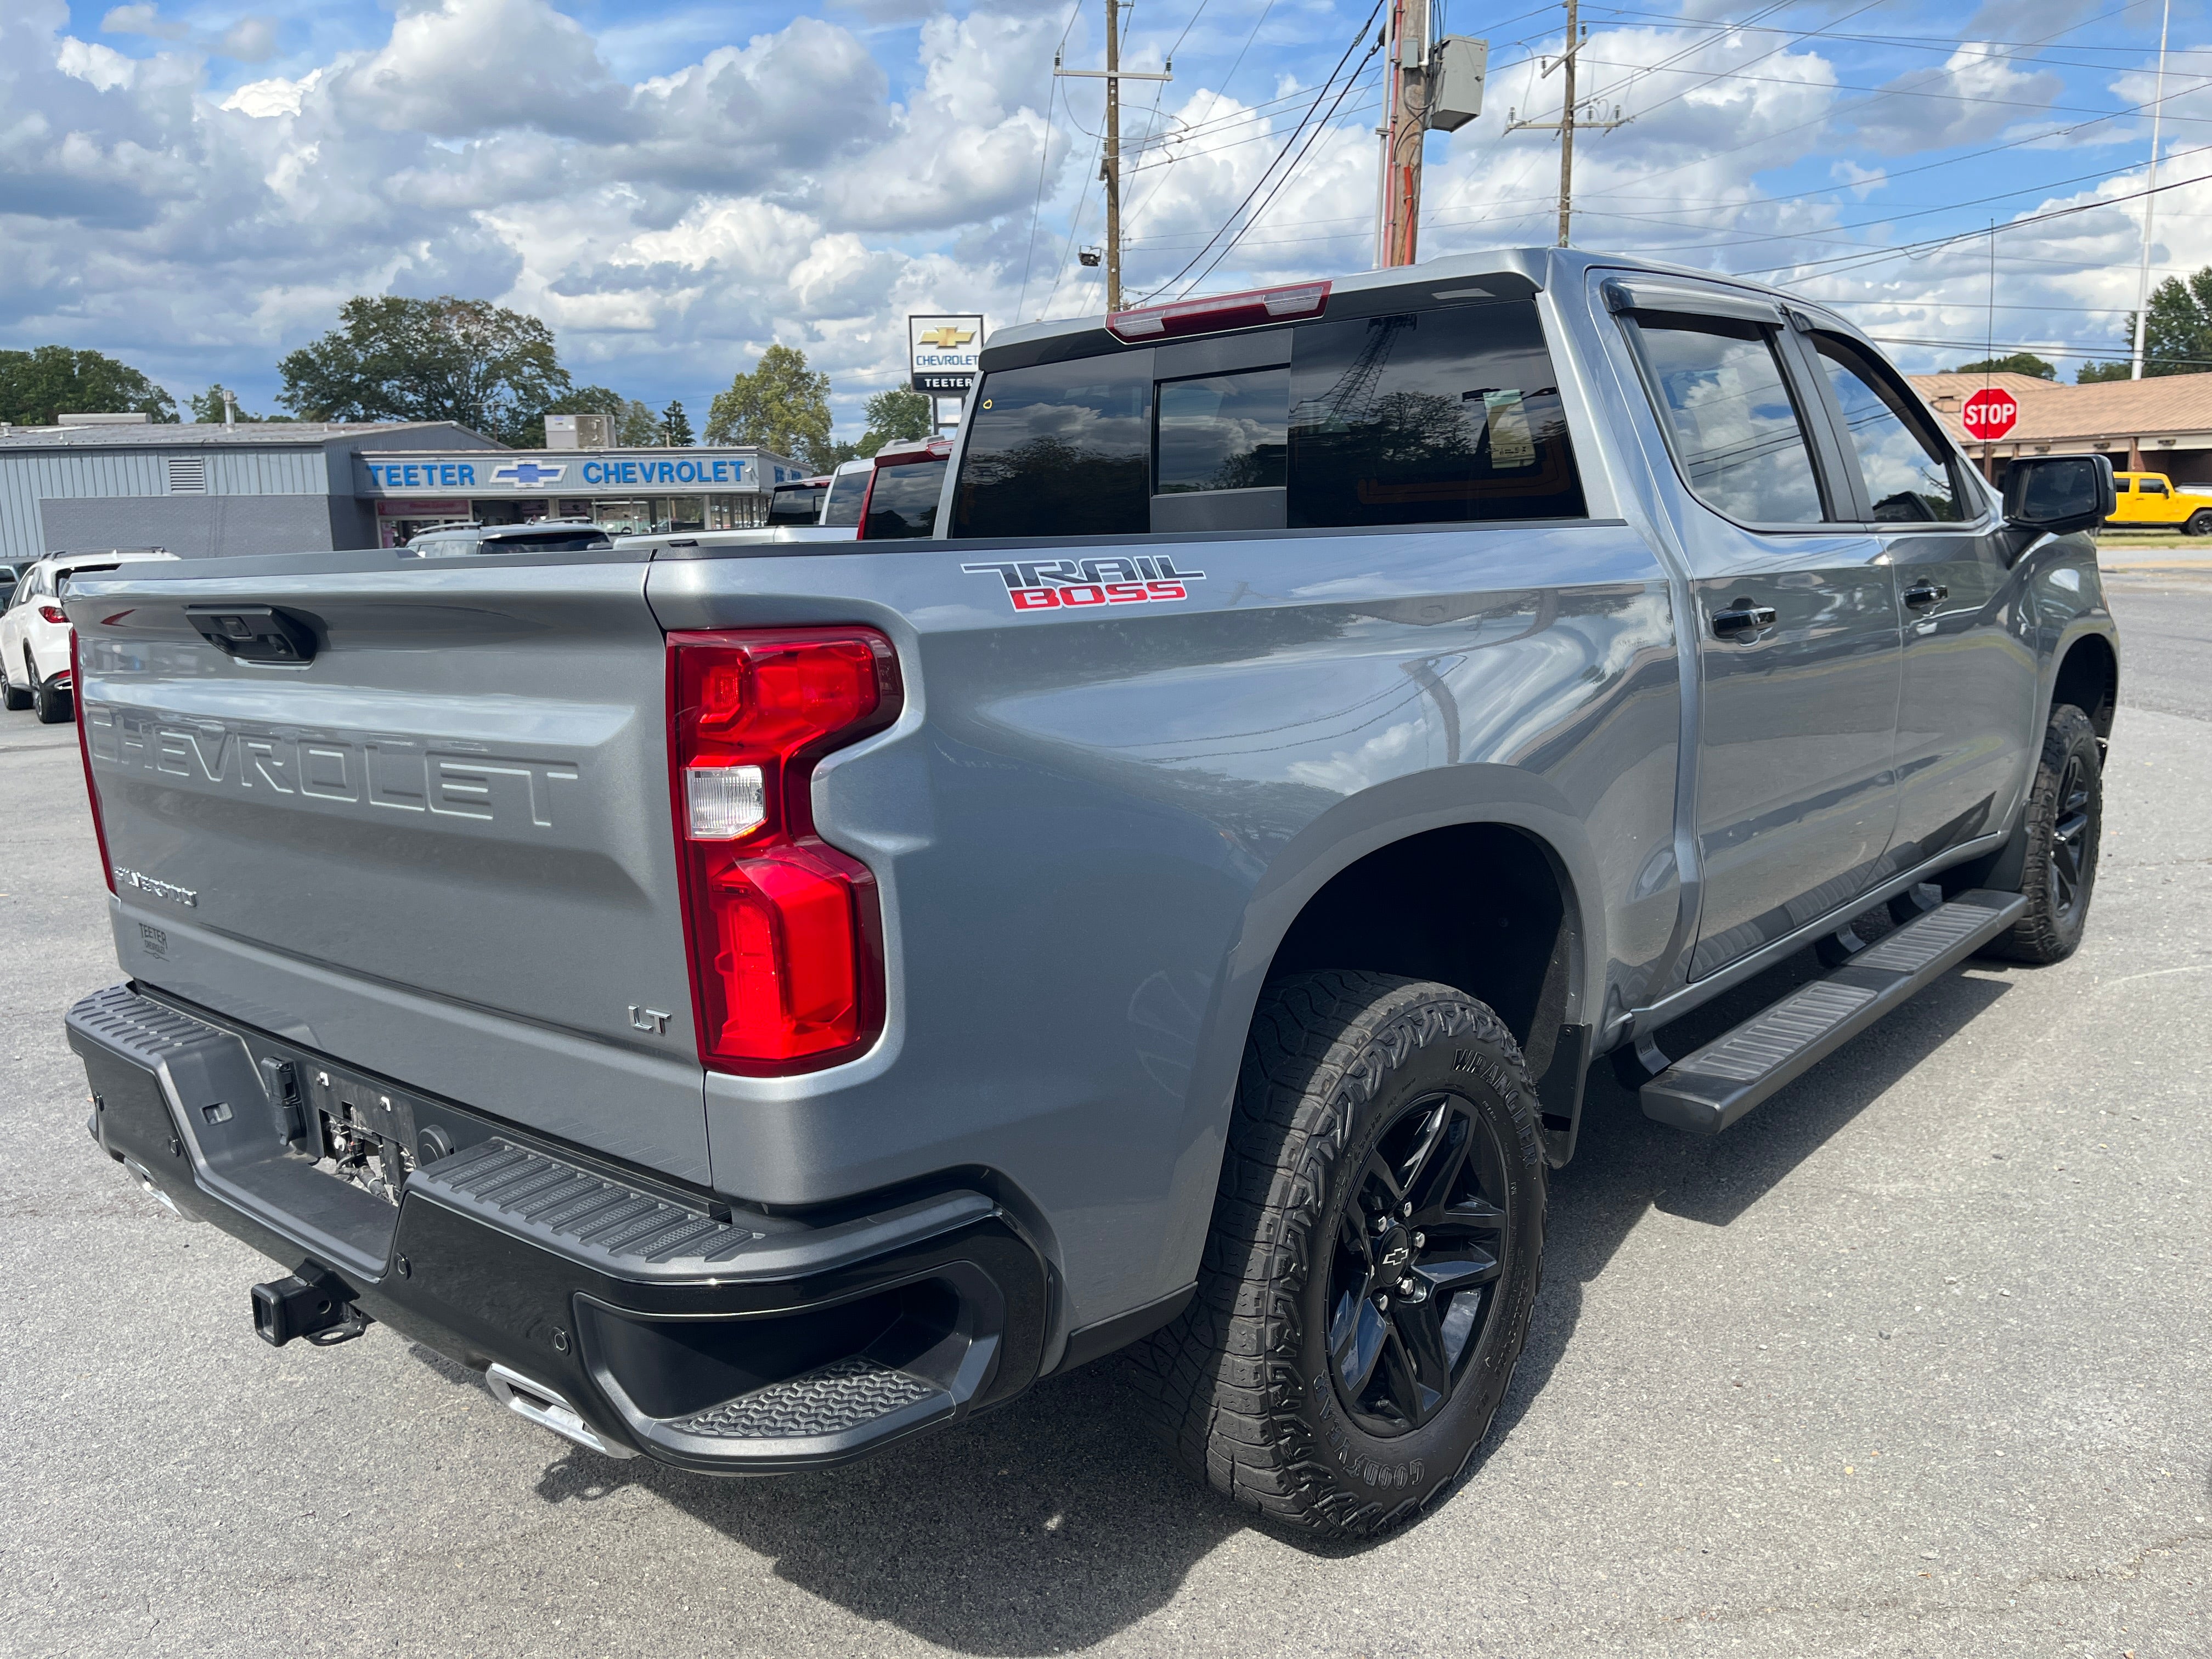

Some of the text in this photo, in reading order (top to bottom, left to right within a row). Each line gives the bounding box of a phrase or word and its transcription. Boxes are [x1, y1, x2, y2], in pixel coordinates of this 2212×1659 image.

[916, 355, 979, 365] CHEVROLET
[924, 379, 973, 387] TEETER
[1965, 403, 2016, 425] STOP
[367, 461, 746, 486] TEETER CHEVROLET
[960, 555, 1207, 588] TRAIL
[1008, 579, 1188, 612] BOSS
[87, 712, 578, 826] CHEVROLET
[139, 923, 168, 950] TEETER
[628, 1005, 672, 1035] LT
[1452, 1048, 1537, 1170] WRANGLER
[1313, 1369, 1425, 1490] GOODYEAR
